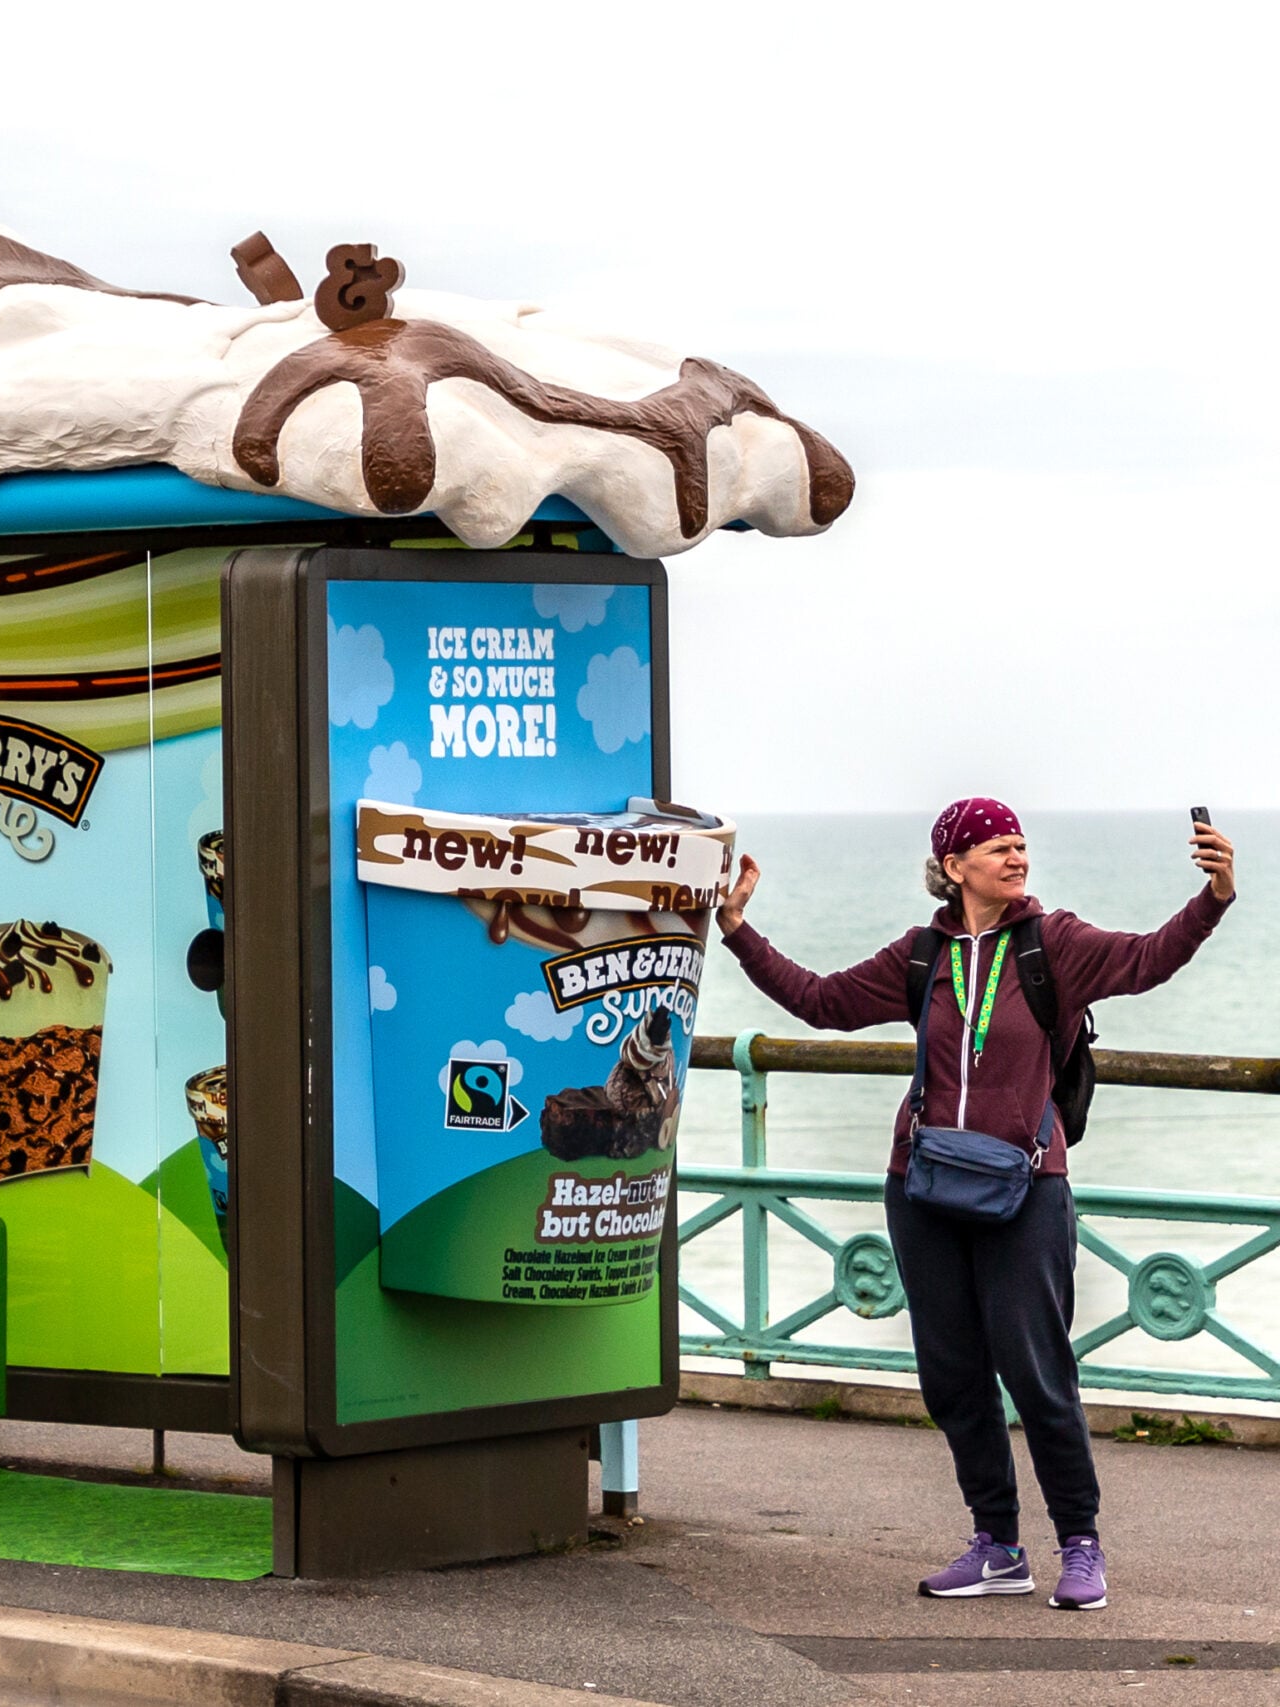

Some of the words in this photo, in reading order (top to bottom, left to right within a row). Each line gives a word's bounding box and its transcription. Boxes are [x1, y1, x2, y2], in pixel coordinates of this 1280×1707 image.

[428, 627, 468, 659] ICE
[471, 627, 554, 660] CREAM
[429, 666, 448, 698] &
[452, 666, 483, 698] SO
[486, 666, 555, 698] MUCH
[429, 704, 557, 758] MORE!
[402, 827, 527, 875] new!
[574, 827, 680, 869] new!
[586, 977, 695, 1046] Sundae
[449, 1114, 501, 1126] FAIRTRADE
[540, 1209, 591, 1238] but
[504, 1248, 551, 1265] Chocolate
[554, 1249, 593, 1265] Hazelnut
[502, 1265, 522, 1281] Salt
[524, 1266, 576, 1284] Chocolatey
[502, 1283, 536, 1300] Cream,
[539, 1284, 588, 1300] Chocolatey
